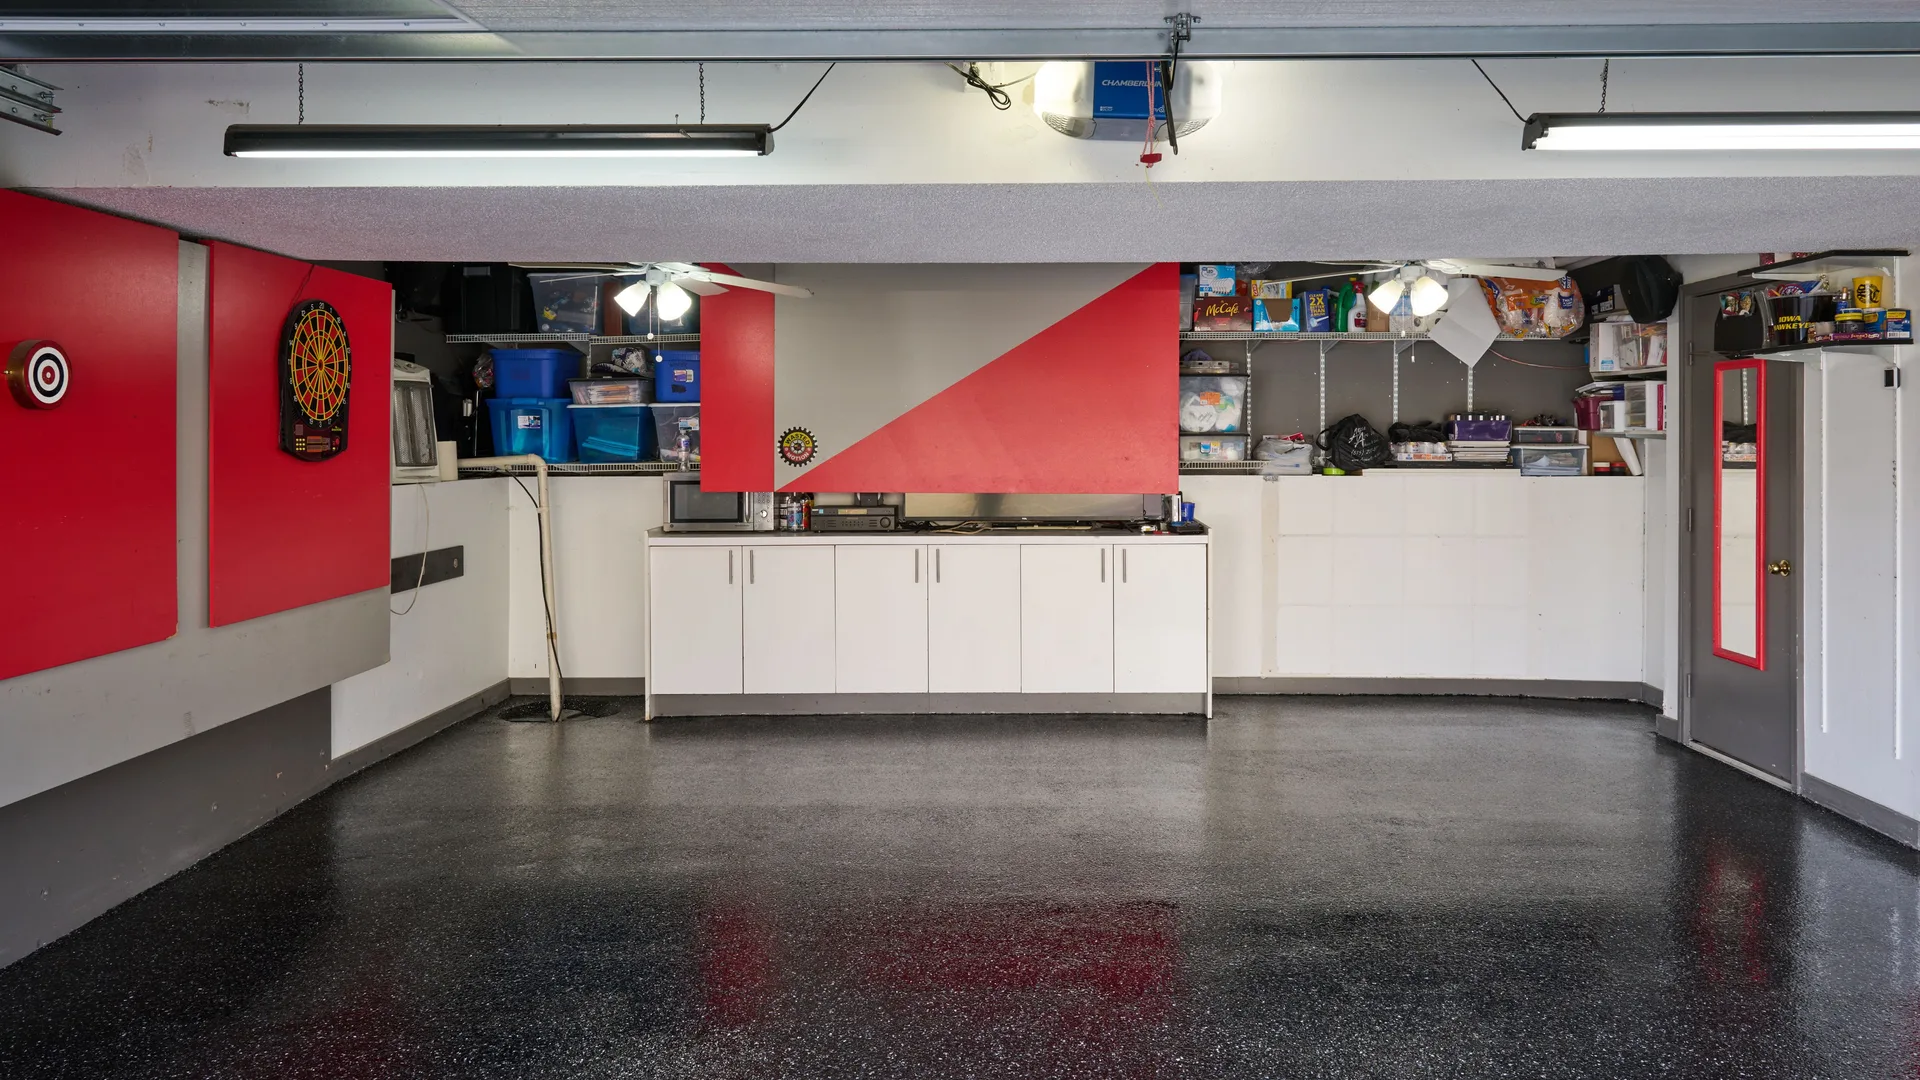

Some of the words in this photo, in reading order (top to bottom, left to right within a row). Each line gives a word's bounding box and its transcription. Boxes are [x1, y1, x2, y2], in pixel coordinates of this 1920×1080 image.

[1779, 315, 1801, 323] IOWA
[786, 433, 810, 445] WASTED
[786, 452, 809, 461] MOTION
